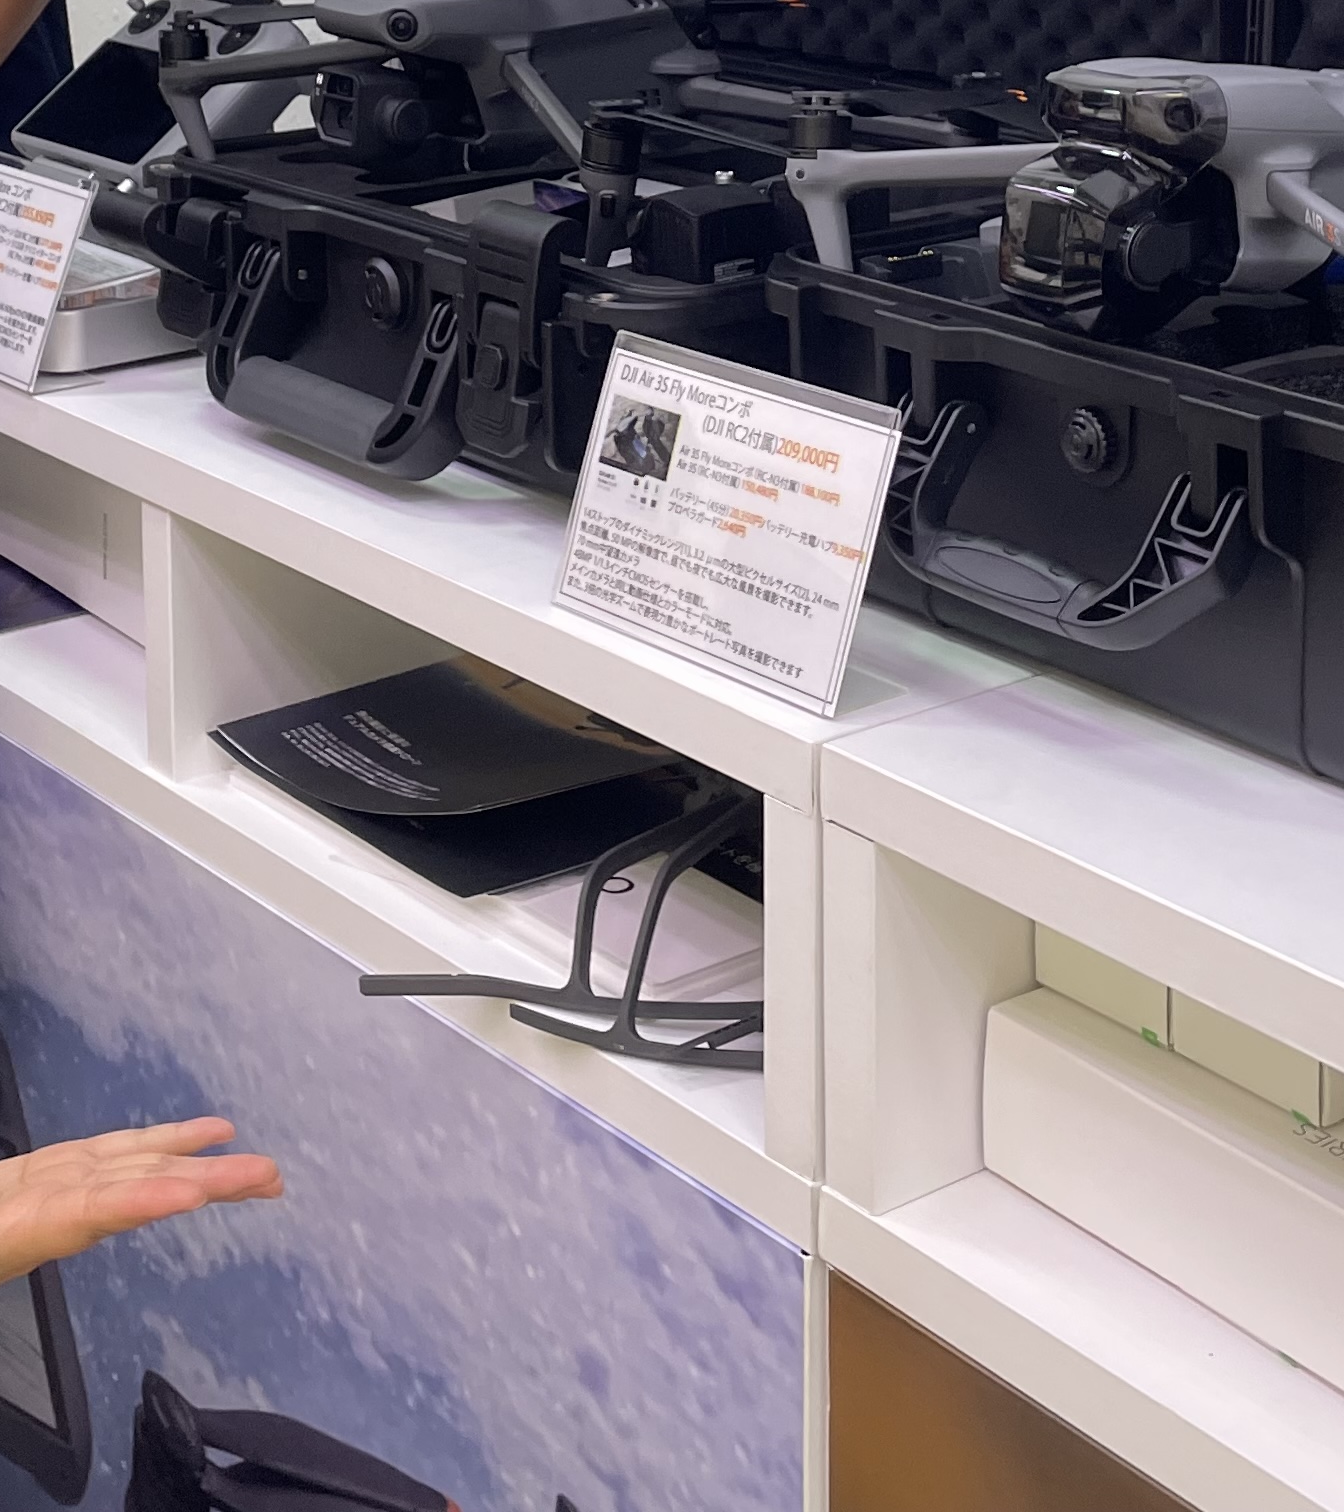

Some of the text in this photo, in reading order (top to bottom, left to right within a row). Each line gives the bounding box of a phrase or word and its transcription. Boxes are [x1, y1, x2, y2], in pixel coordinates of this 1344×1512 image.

[1304, 207, 1326, 238] AIR
[620, 366, 754, 418] DJI Air 3S Fly Moreコンボ
[702, 416, 726, 436] (DJI
